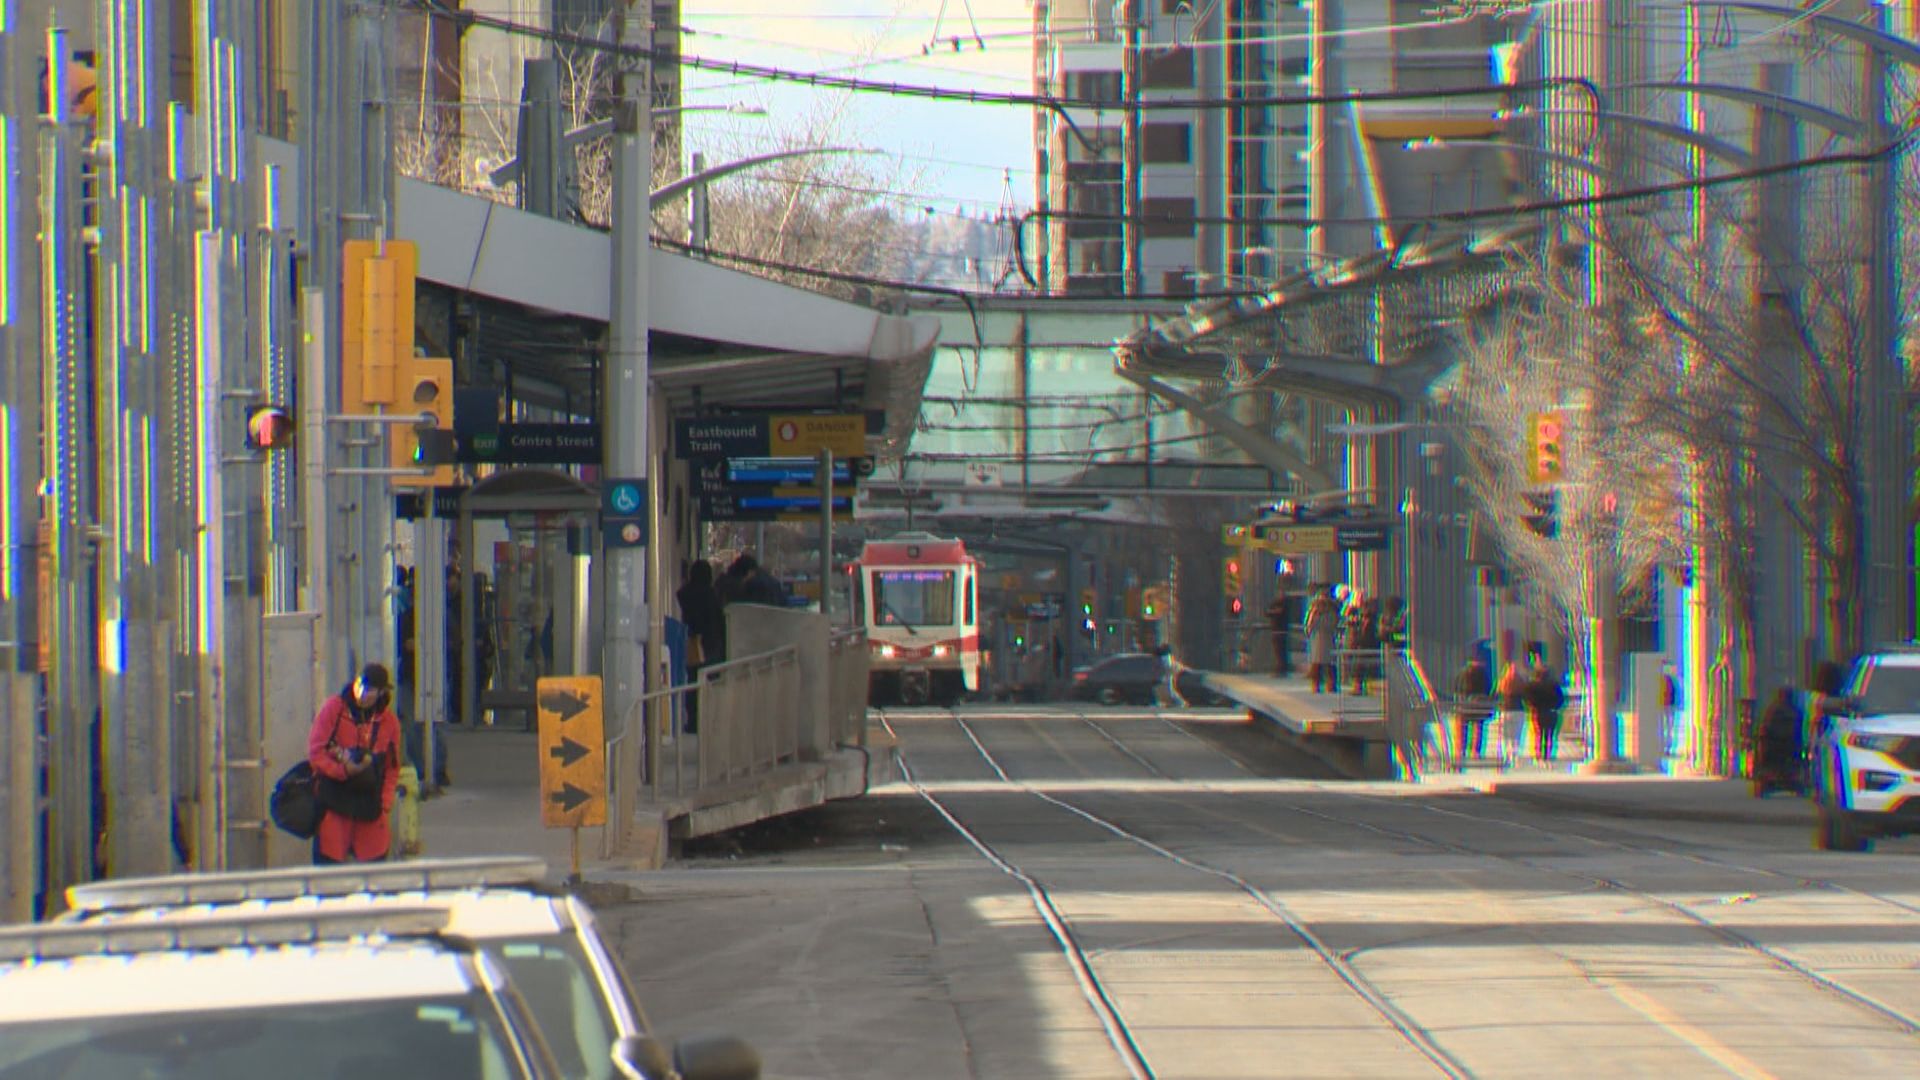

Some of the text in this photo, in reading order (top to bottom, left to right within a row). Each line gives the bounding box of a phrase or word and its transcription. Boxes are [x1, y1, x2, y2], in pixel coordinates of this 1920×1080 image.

[689, 425, 756, 438] Eastbound
[473, 438, 498, 449] EXIT
[511, 434, 595, 447] Centre Street
[689, 439, 722, 451] Train
[703, 480, 723, 491] Trai
